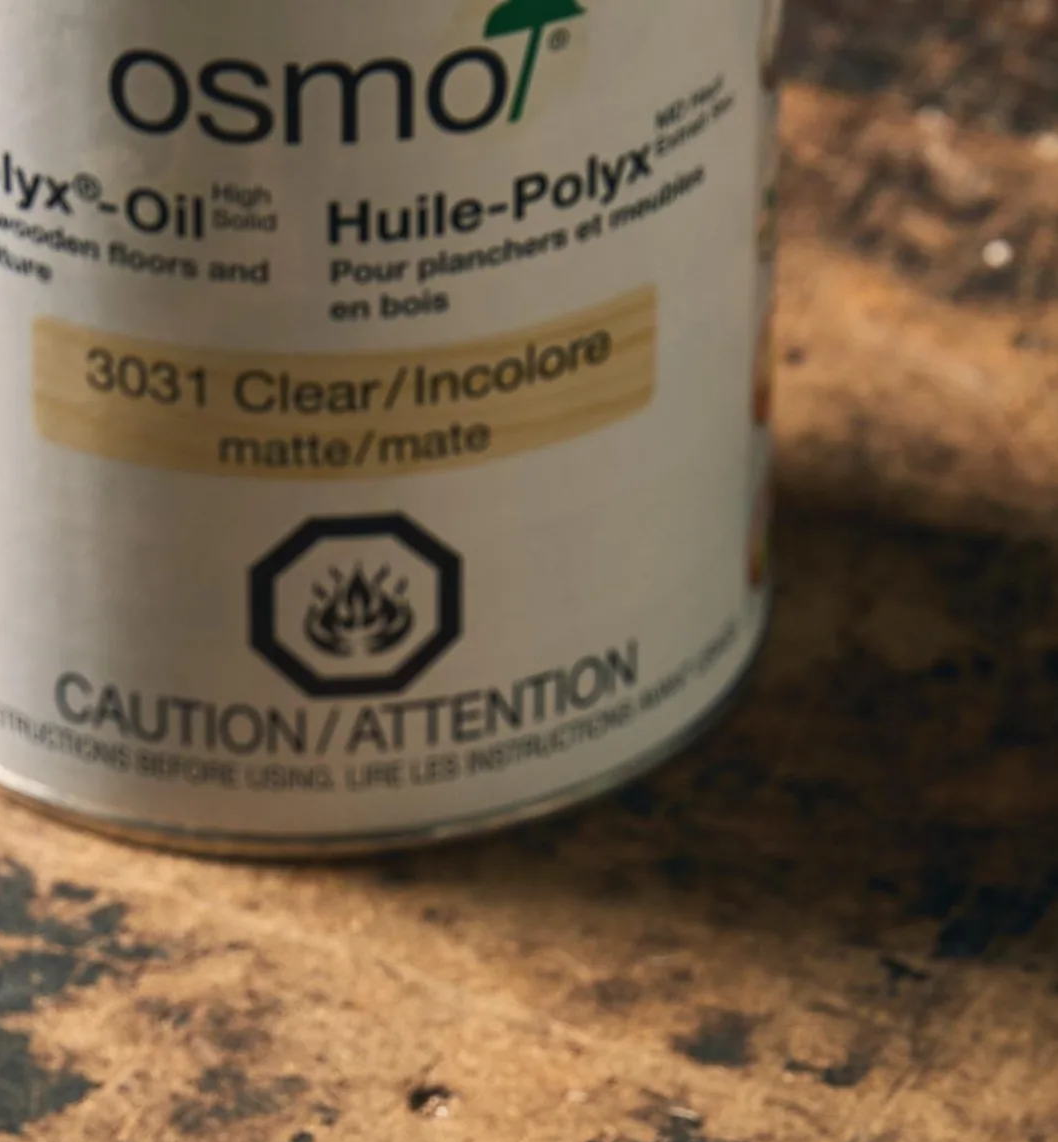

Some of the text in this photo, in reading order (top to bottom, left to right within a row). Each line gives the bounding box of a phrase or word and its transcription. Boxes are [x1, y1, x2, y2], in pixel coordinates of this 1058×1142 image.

[109, 46, 509, 146] osmo
[211, 182, 273, 207] High
[327, 144, 652, 246] Huile-Polyx
[211, 208, 277, 233] Solid
[108, 241, 199, 281] floors
[207, 259, 270, 285] and
[329, 256, 410, 285] Pour
[417, 226, 568, 283] planchers
[574, 214, 603, 242] et
[328, 288, 450, 321] en bois
[85, 329, 613, 416] 3031 Clear/Incolore
[218, 421, 492, 470] matte/mate
